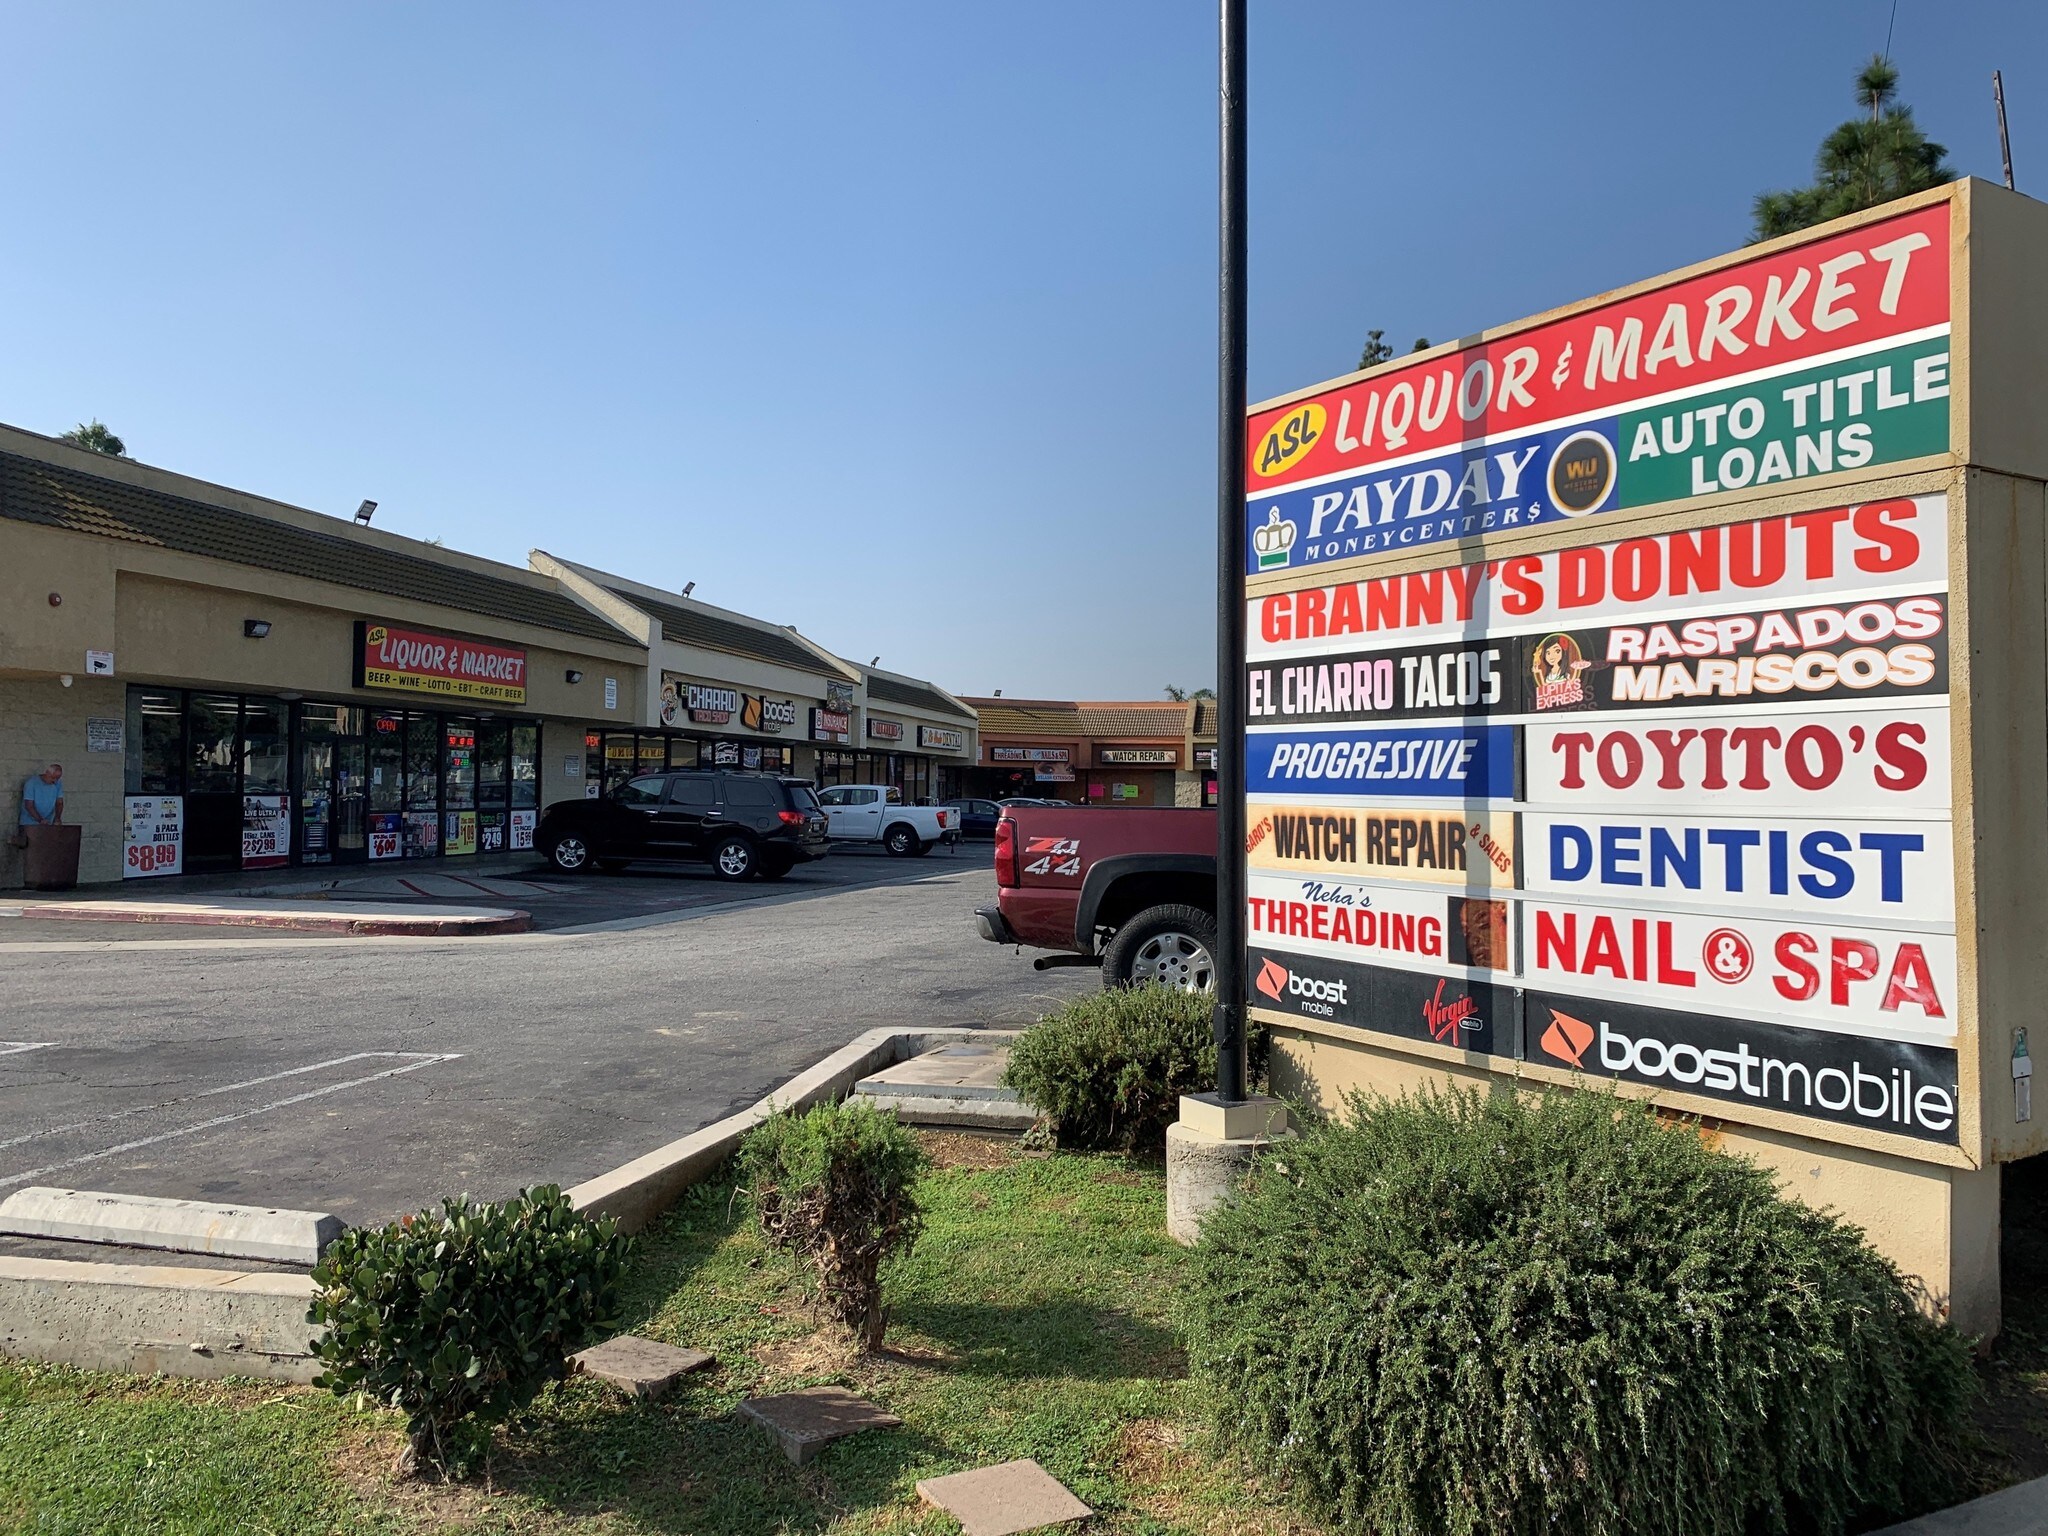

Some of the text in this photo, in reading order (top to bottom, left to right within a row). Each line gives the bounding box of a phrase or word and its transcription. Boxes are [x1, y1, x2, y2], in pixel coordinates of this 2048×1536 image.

[1261, 231, 1932, 472] ASL LIQUOR & MARKET
[1629, 352, 1950, 463] AUTO TITLE
[1566, 456, 1598, 480] WU
[1691, 423, 1874, 496] LOANS
[1307, 445, 1542, 540] PAYDAY
[1261, 497, 1921, 644] GRANNY'S DONUTS
[1607, 597, 1944, 663] RASPADOS
[368, 629, 524, 682] ASL LIQUOR & MARKET
[1612, 644, 1936, 702] MARISCOS
[368, 671, 523, 699] BEER WINE LOTTO EBT CRAFT BEER
[681, 684, 736, 713] EL CHARRO
[1249, 648, 1501, 717] EL CHARRO TACOS
[1536, 689, 1584, 711] EXPRESS
[376, 719, 397, 732] OPEN
[763, 697, 795, 724] boost
[763, 721, 782, 732] mobile
[995, 752, 1023, 760] THREADING
[1059, 751, 1068, 760] SPA
[1112, 751, 1166, 762] WATCH REPAIR
[1267, 738, 1479, 780] PROGRESSIVE
[1551, 720, 1929, 792] TOYITO'S
[153, 833, 180, 842] BOTTLES
[161, 824, 178, 833] PACK
[260, 832, 276, 840] CANS
[1273, 815, 1357, 864] WATCH
[1366, 816, 1467, 871] REPAIR
[1479, 833, 1512, 874] SALES
[1549, 824, 1925, 903] DENTIST
[1301, 881, 1373, 908] Neha's
[1248, 897, 1442, 958] THREADING
[1535, 910, 1697, 988] NAIL
[1771, 931, 1947, 1019] SPA
[1289, 970, 1348, 1005] boost
[1301, 1001, 1334, 1017] mobile
[1423, 978, 1480, 1047] Virgin
